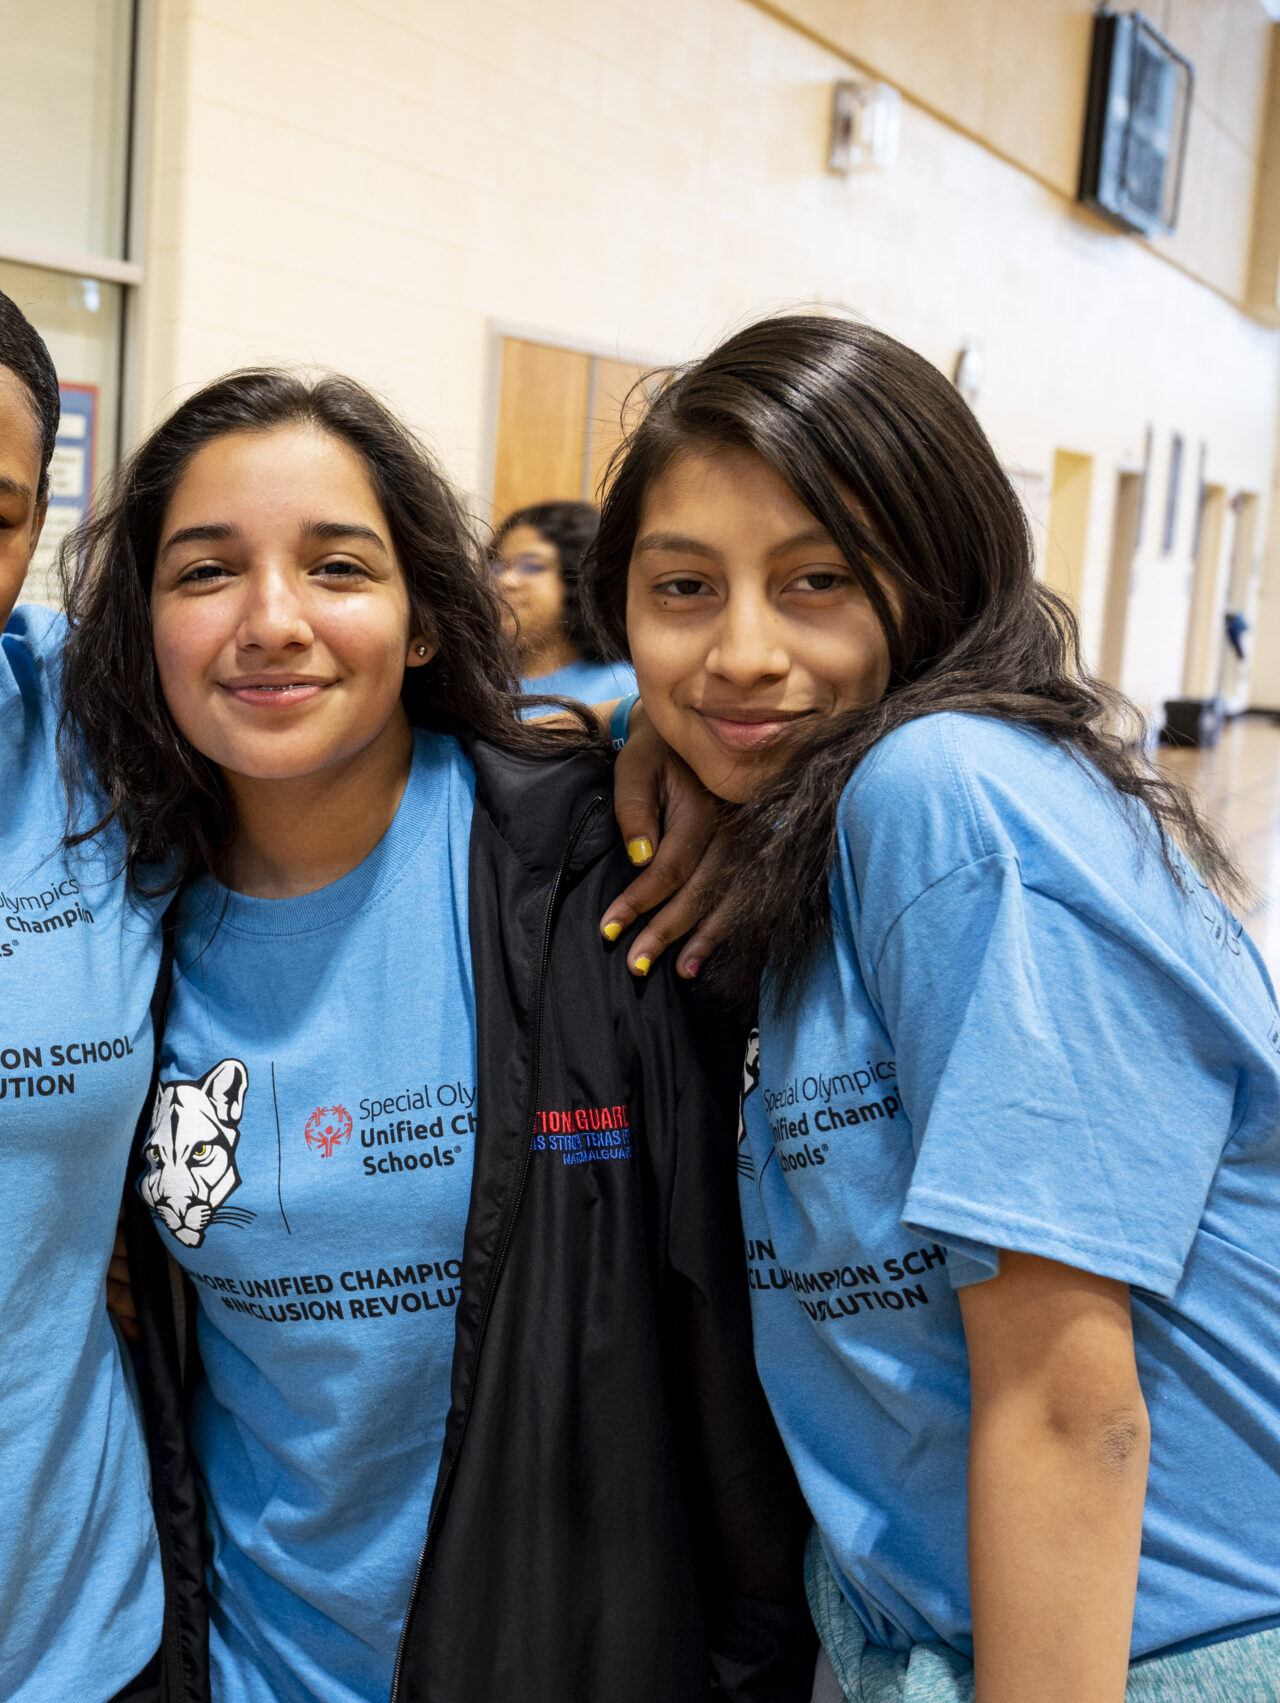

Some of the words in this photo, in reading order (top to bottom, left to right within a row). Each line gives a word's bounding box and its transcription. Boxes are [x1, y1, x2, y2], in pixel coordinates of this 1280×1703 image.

[5, 901, 95, 933] Champin
[50, 1035, 134, 1066] SCHOOL
[802, 1060, 897, 1104] Olympics
[359, 1084, 433, 1122] Special
[360, 1115, 445, 1148] Unified
[883, 1243, 948, 1281] SCH
[239, 1274, 334, 1298] UNIFIED
[799, 1283, 929, 1322] VOLUTION
[221, 1297, 345, 1323] #INCLUSION
